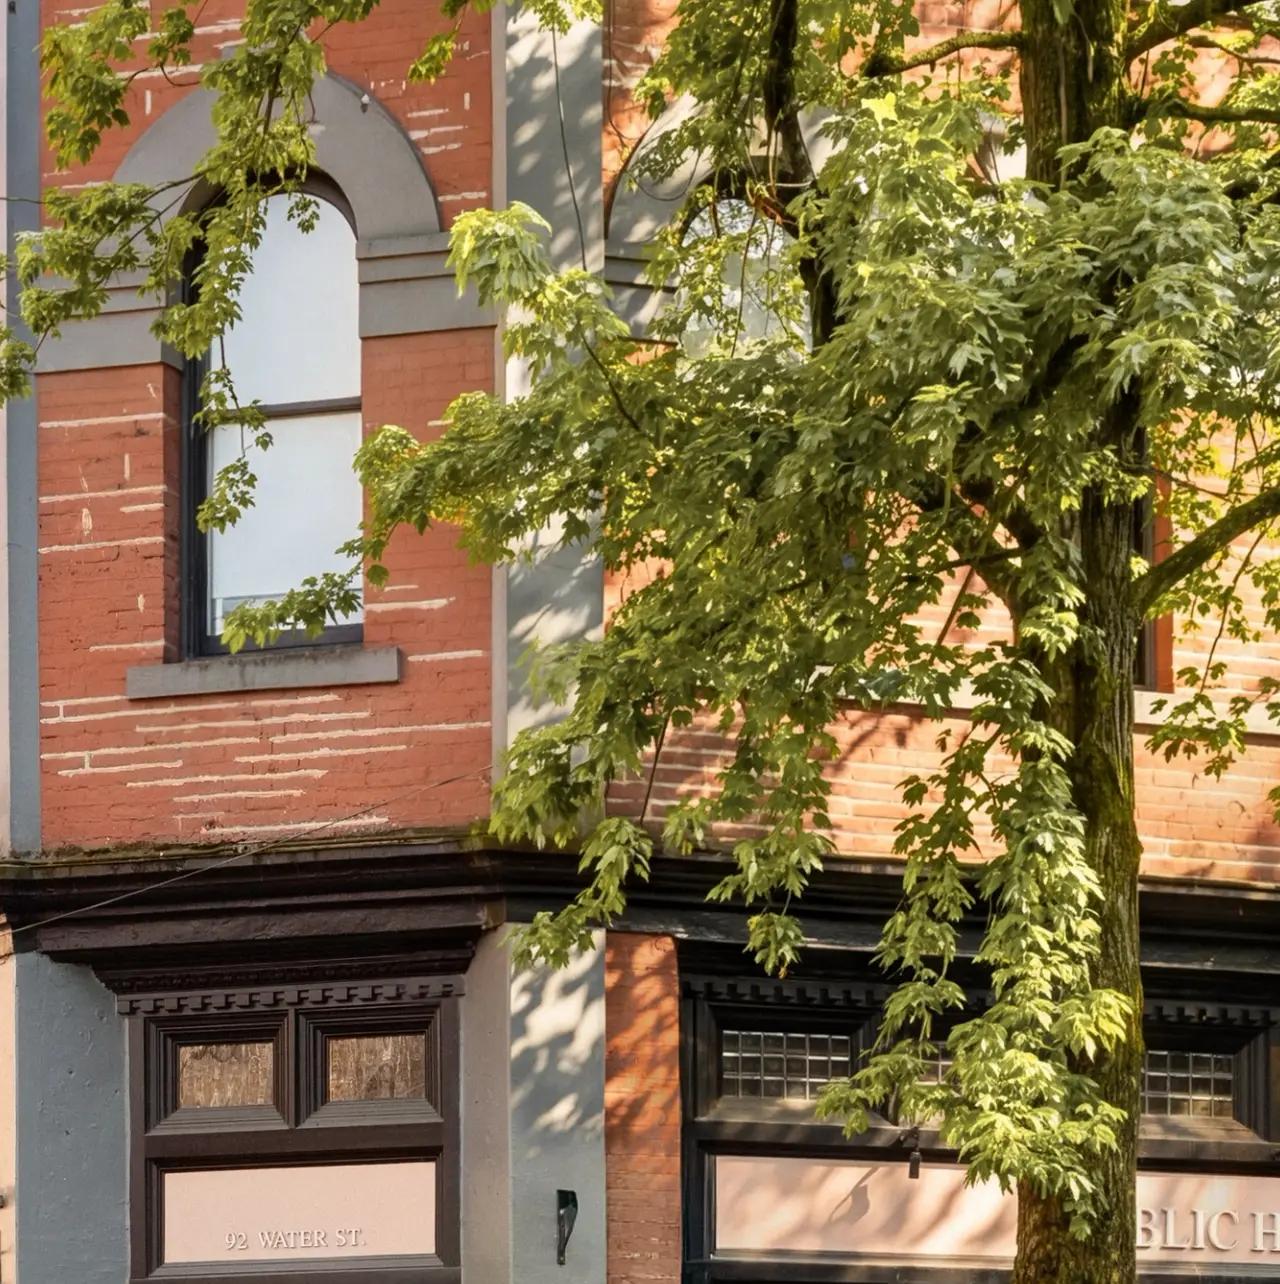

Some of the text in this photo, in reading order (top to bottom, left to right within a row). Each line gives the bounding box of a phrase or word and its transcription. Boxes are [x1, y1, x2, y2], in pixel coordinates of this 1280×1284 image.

[224, 1227, 368, 1250] 92 WATER ST.
[1135, 1207, 1240, 1252] BLIC
